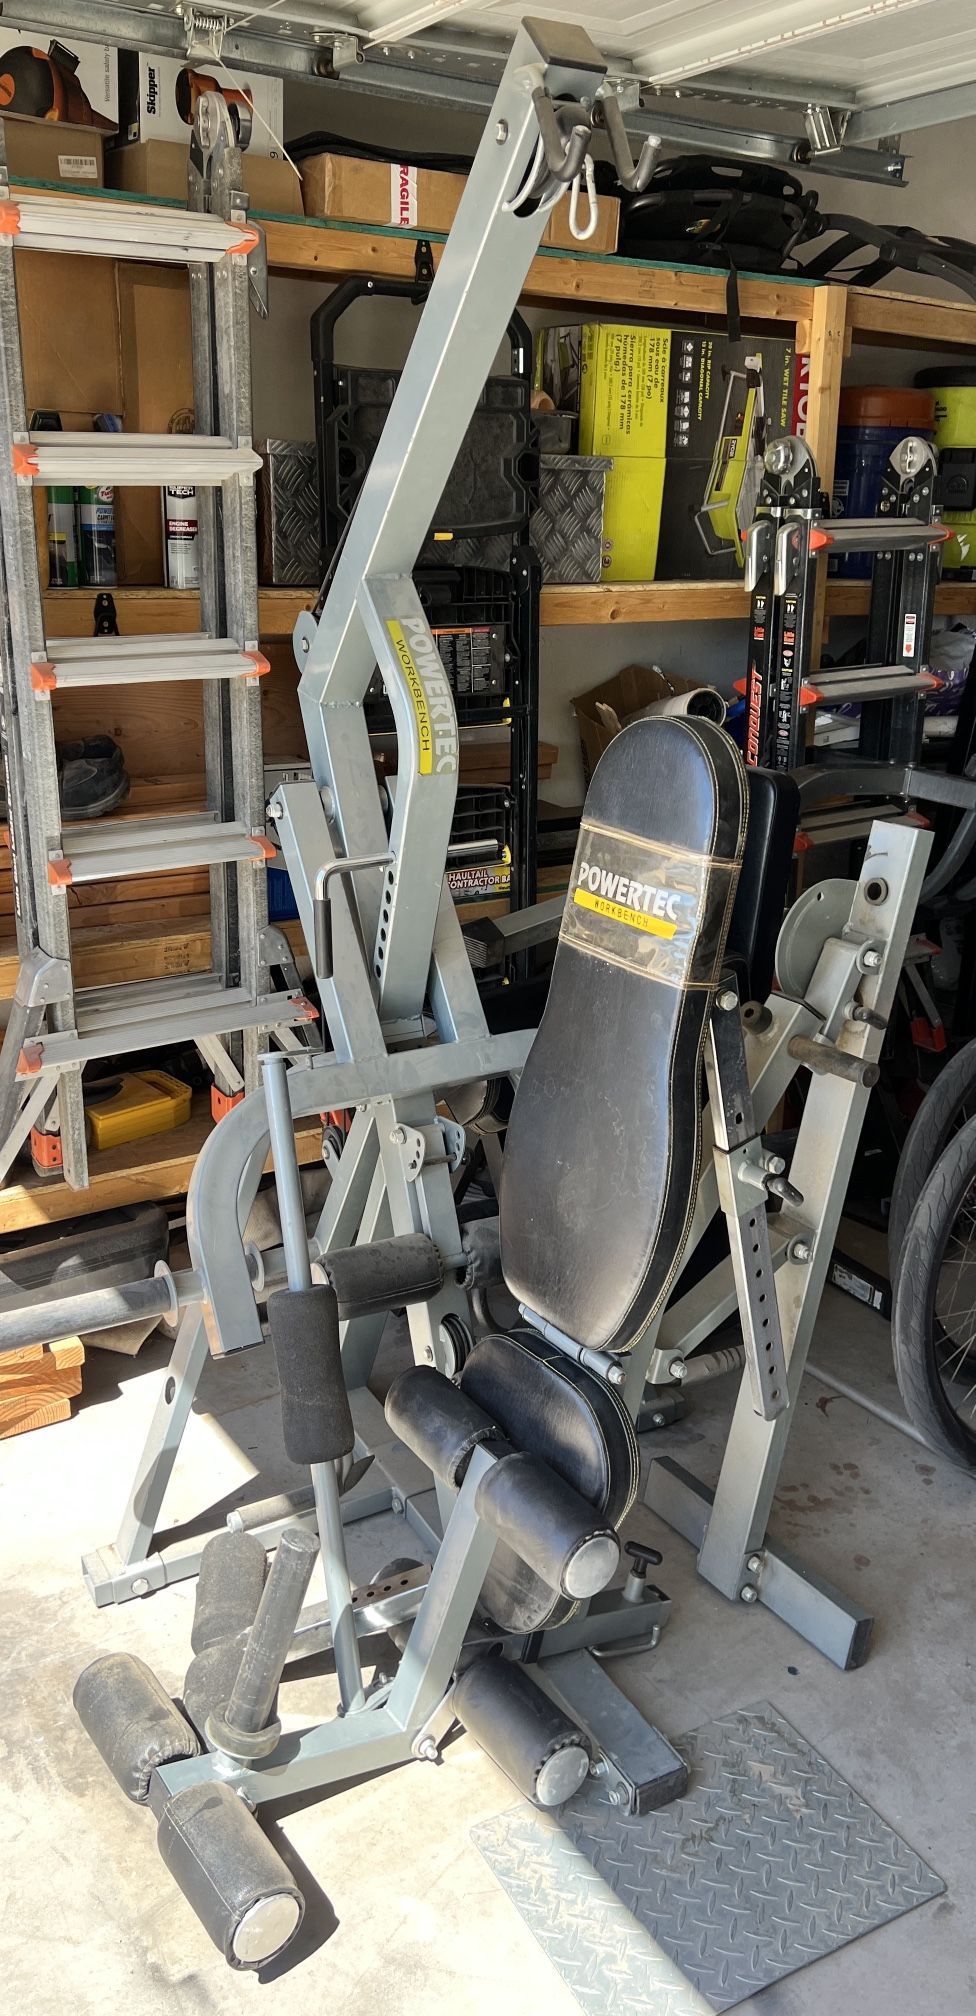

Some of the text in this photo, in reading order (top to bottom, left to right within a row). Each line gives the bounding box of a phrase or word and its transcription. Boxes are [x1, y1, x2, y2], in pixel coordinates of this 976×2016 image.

[147, 66, 158, 115] Skipper
[615, 334, 622, 343] (7
[628, 334, 636, 363] Sierra
[648, 355, 653, 372] mm
[621, 379, 628, 391] de
[647, 374, 653, 383] (7
[653, 377, 660, 389] de
[619, 412, 625, 430] mm
[396, 639, 431, 751] WORKBENCH
[401, 617, 457, 773] POWERTEC
[747, 671, 763, 767] CONQUEST
[448, 868, 488, 881] HAULTAIL
[448, 876, 500, 889] ONTRACTOR
[577, 861, 682, 921] POWERTEC
[594, 899, 649, 928] WORKBENCH
